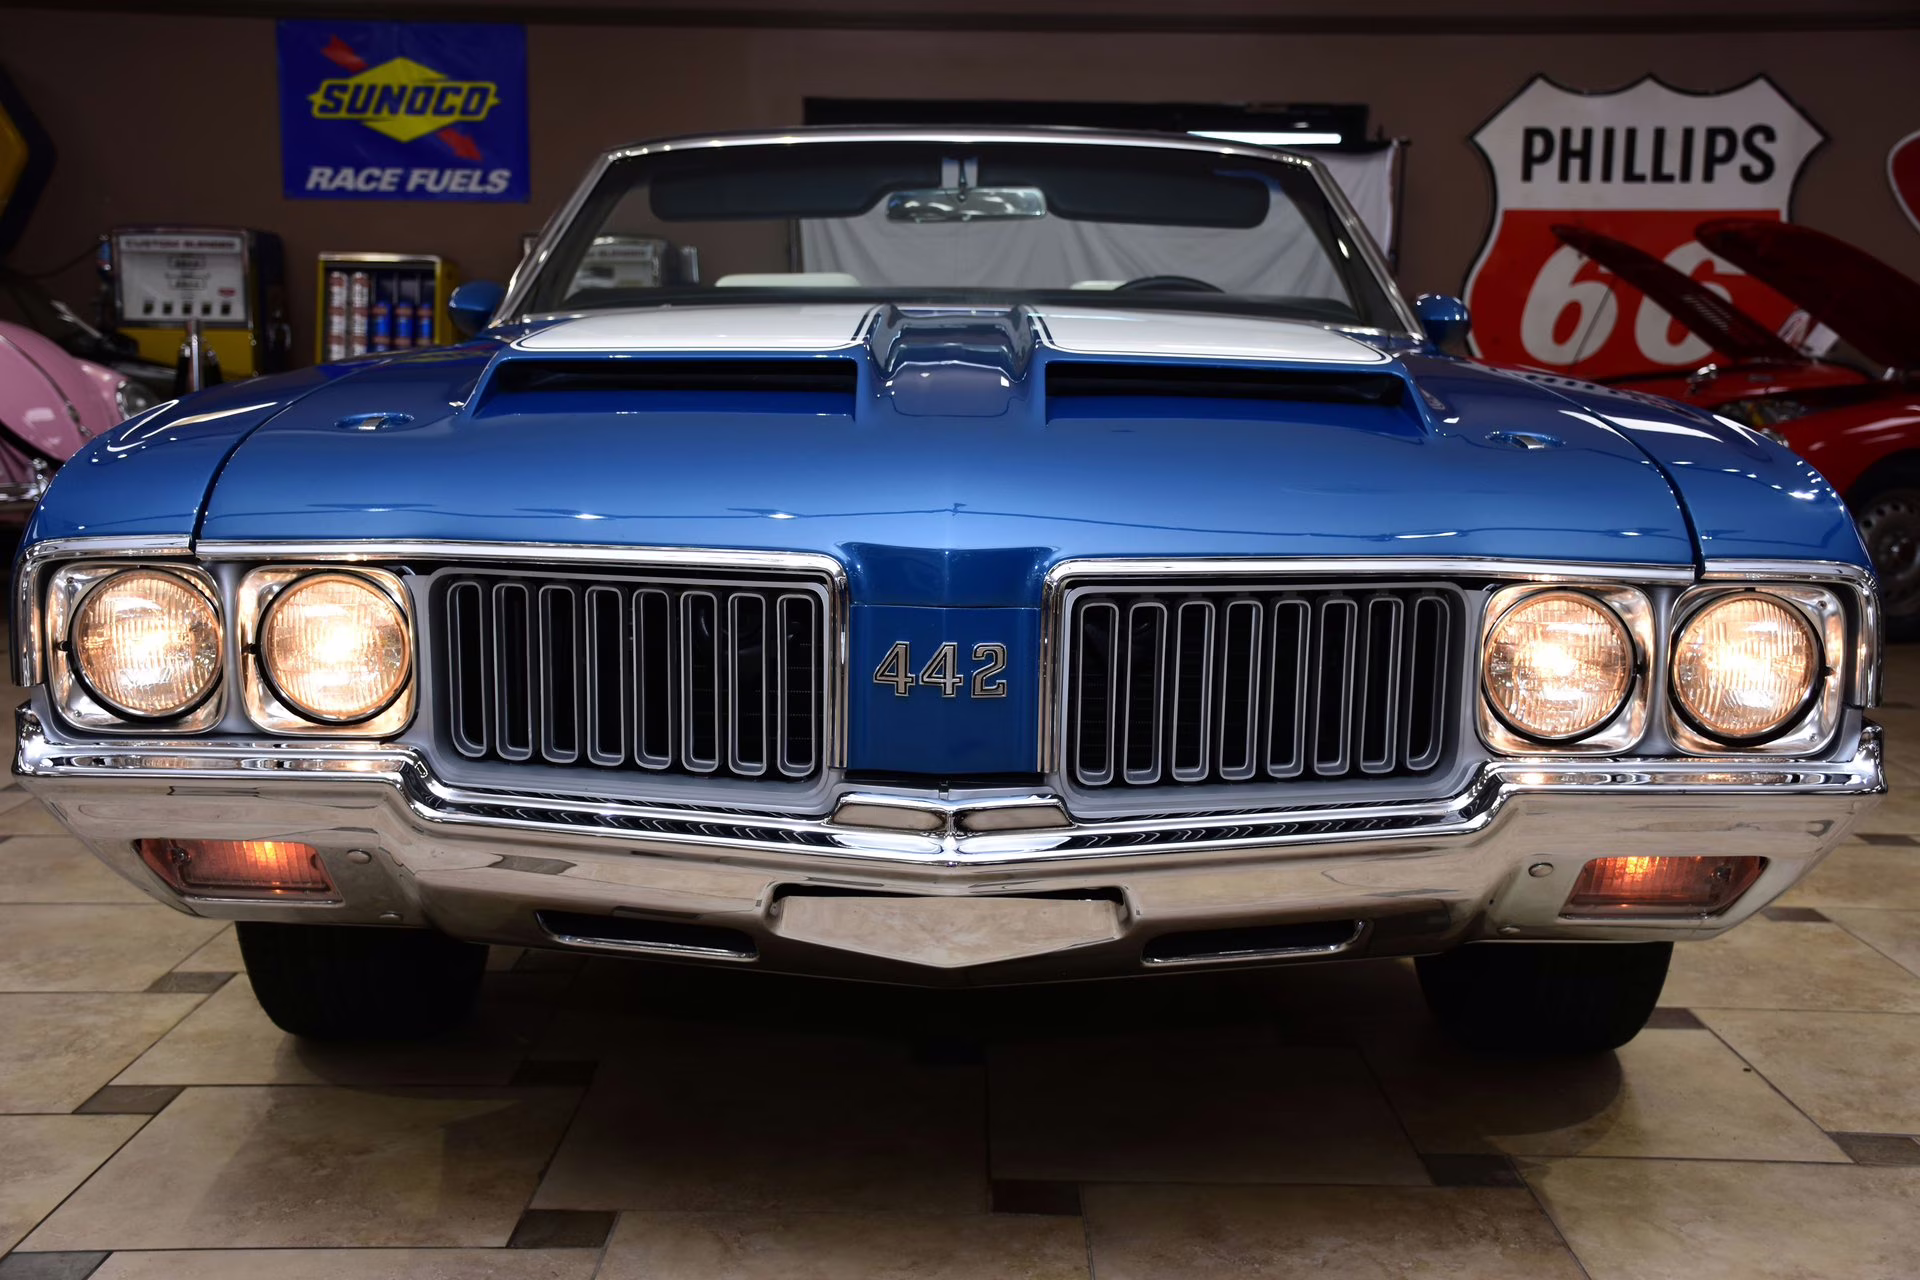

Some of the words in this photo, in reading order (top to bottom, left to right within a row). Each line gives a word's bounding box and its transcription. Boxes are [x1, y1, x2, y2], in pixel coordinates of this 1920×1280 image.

[316, 83, 492, 117] SUNOCO
[305, 166, 404, 191] RACE
[406, 168, 511, 194] FUELS
[1521, 124, 1777, 184] PHILLIPS
[1520, 240, 1746, 366] 66
[873, 640, 1007, 699] 442
